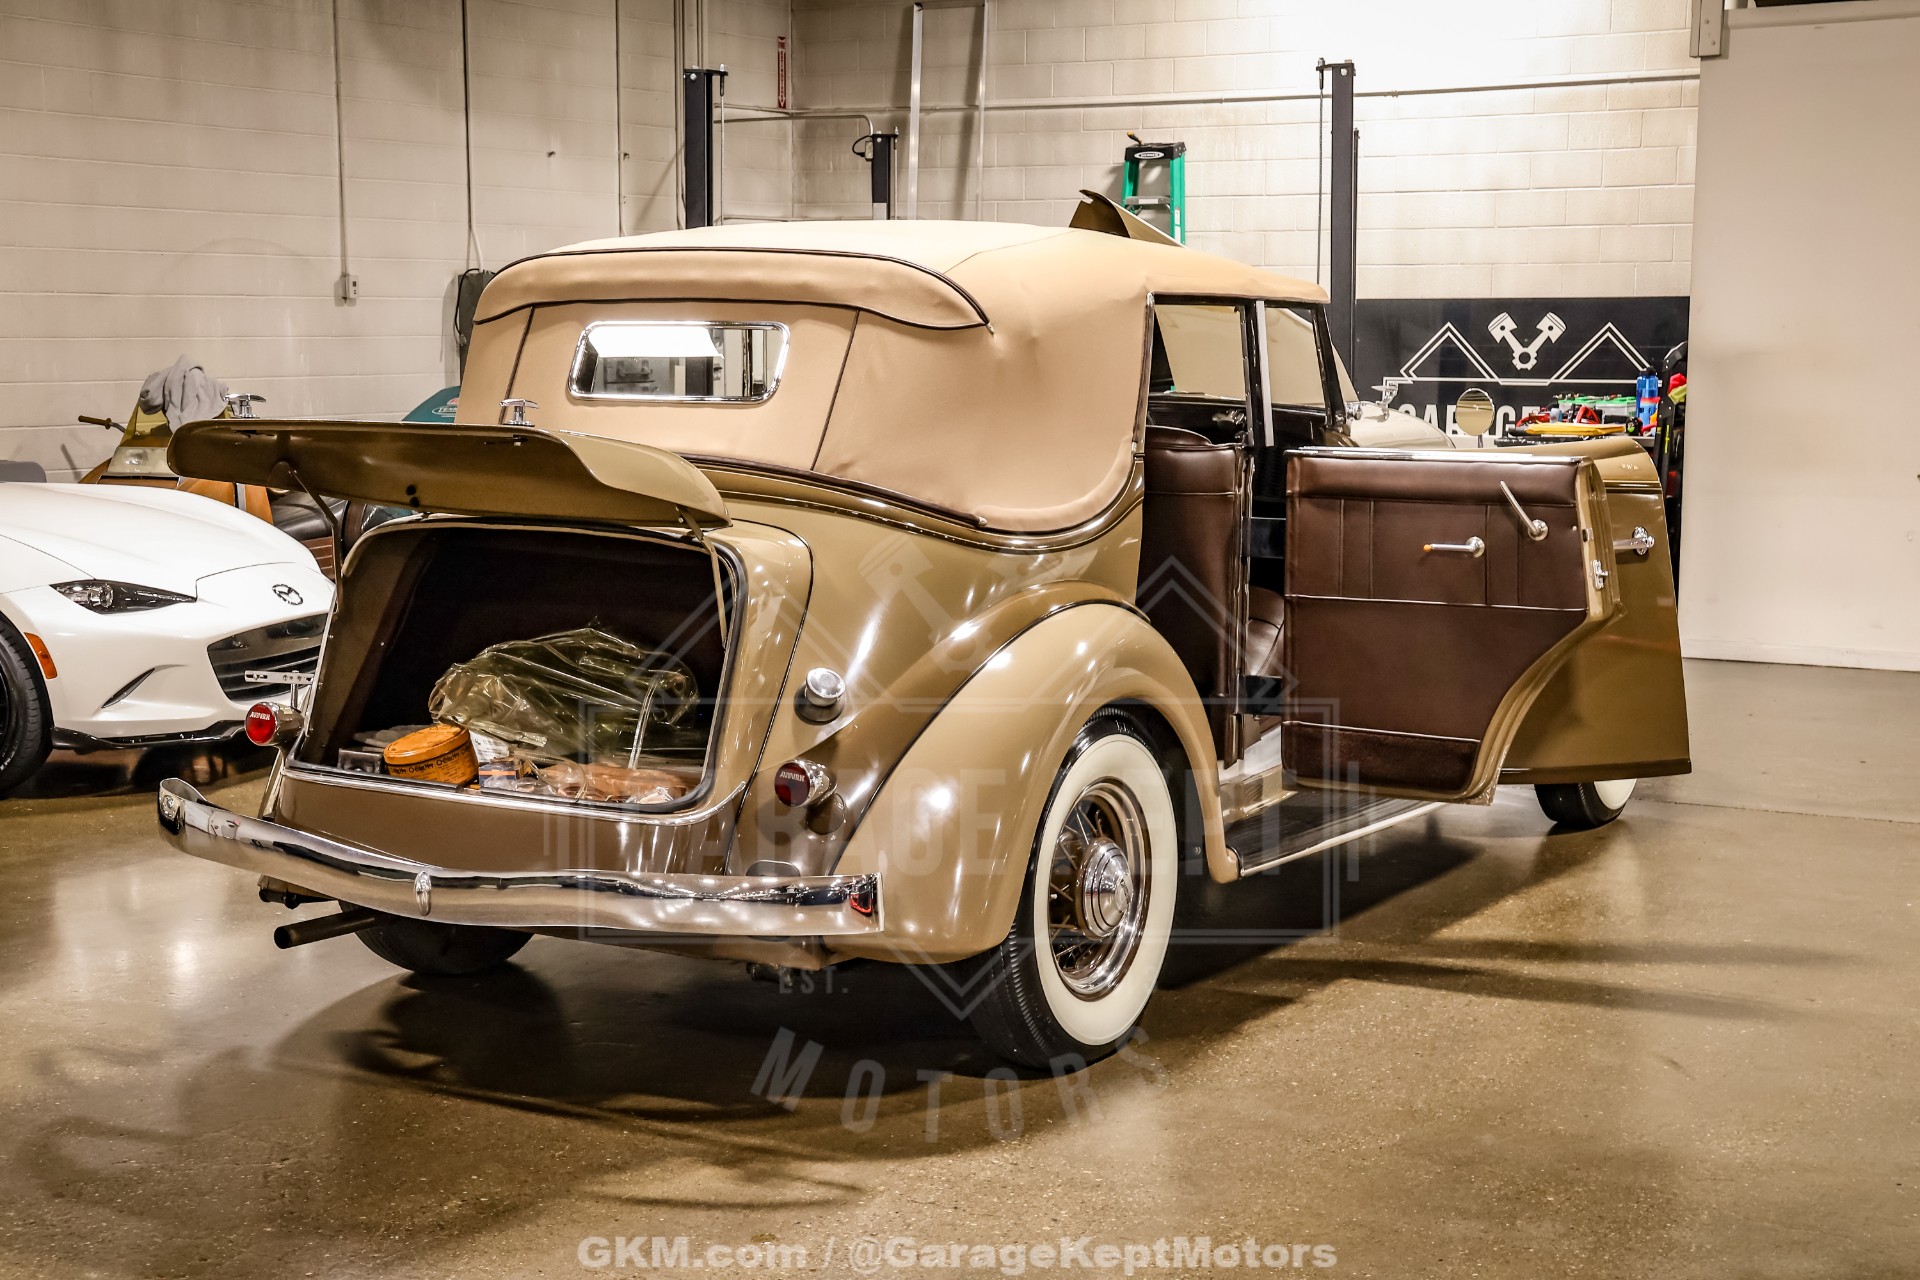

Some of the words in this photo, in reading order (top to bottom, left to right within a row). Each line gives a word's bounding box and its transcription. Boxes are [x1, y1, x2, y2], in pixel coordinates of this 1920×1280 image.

[1399, 404, 1541, 438] ARG
[250, 711, 271, 721] AUBURN
[780, 771, 805, 782] AUBURN
